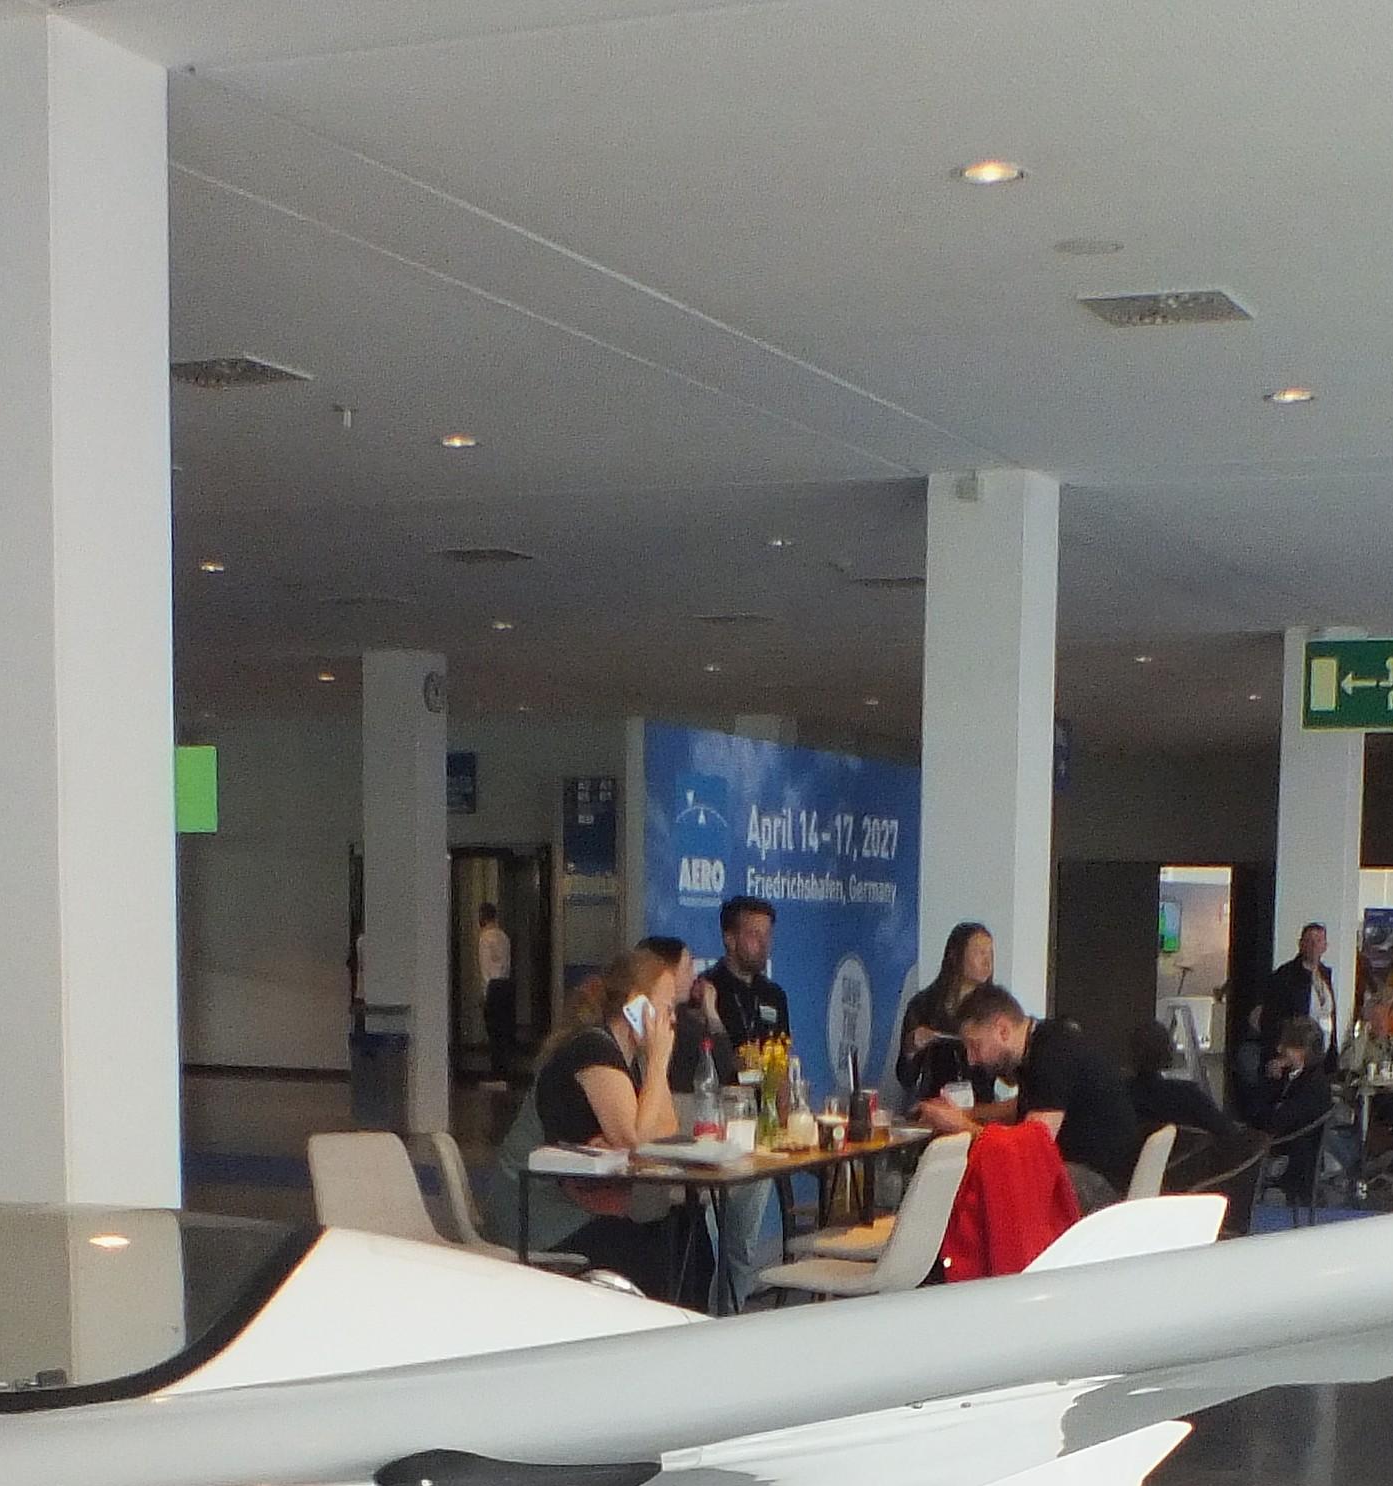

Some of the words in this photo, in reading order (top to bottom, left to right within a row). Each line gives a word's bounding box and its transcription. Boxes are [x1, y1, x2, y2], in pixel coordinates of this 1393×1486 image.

[746, 804, 794, 861] April
[799, 809, 819, 853] 14
[835, 813, 857, 862] 17,
[862, 816, 899, 861] 2027
[679, 855, 725, 893] AERO
[849, 873, 898, 908] Germany
